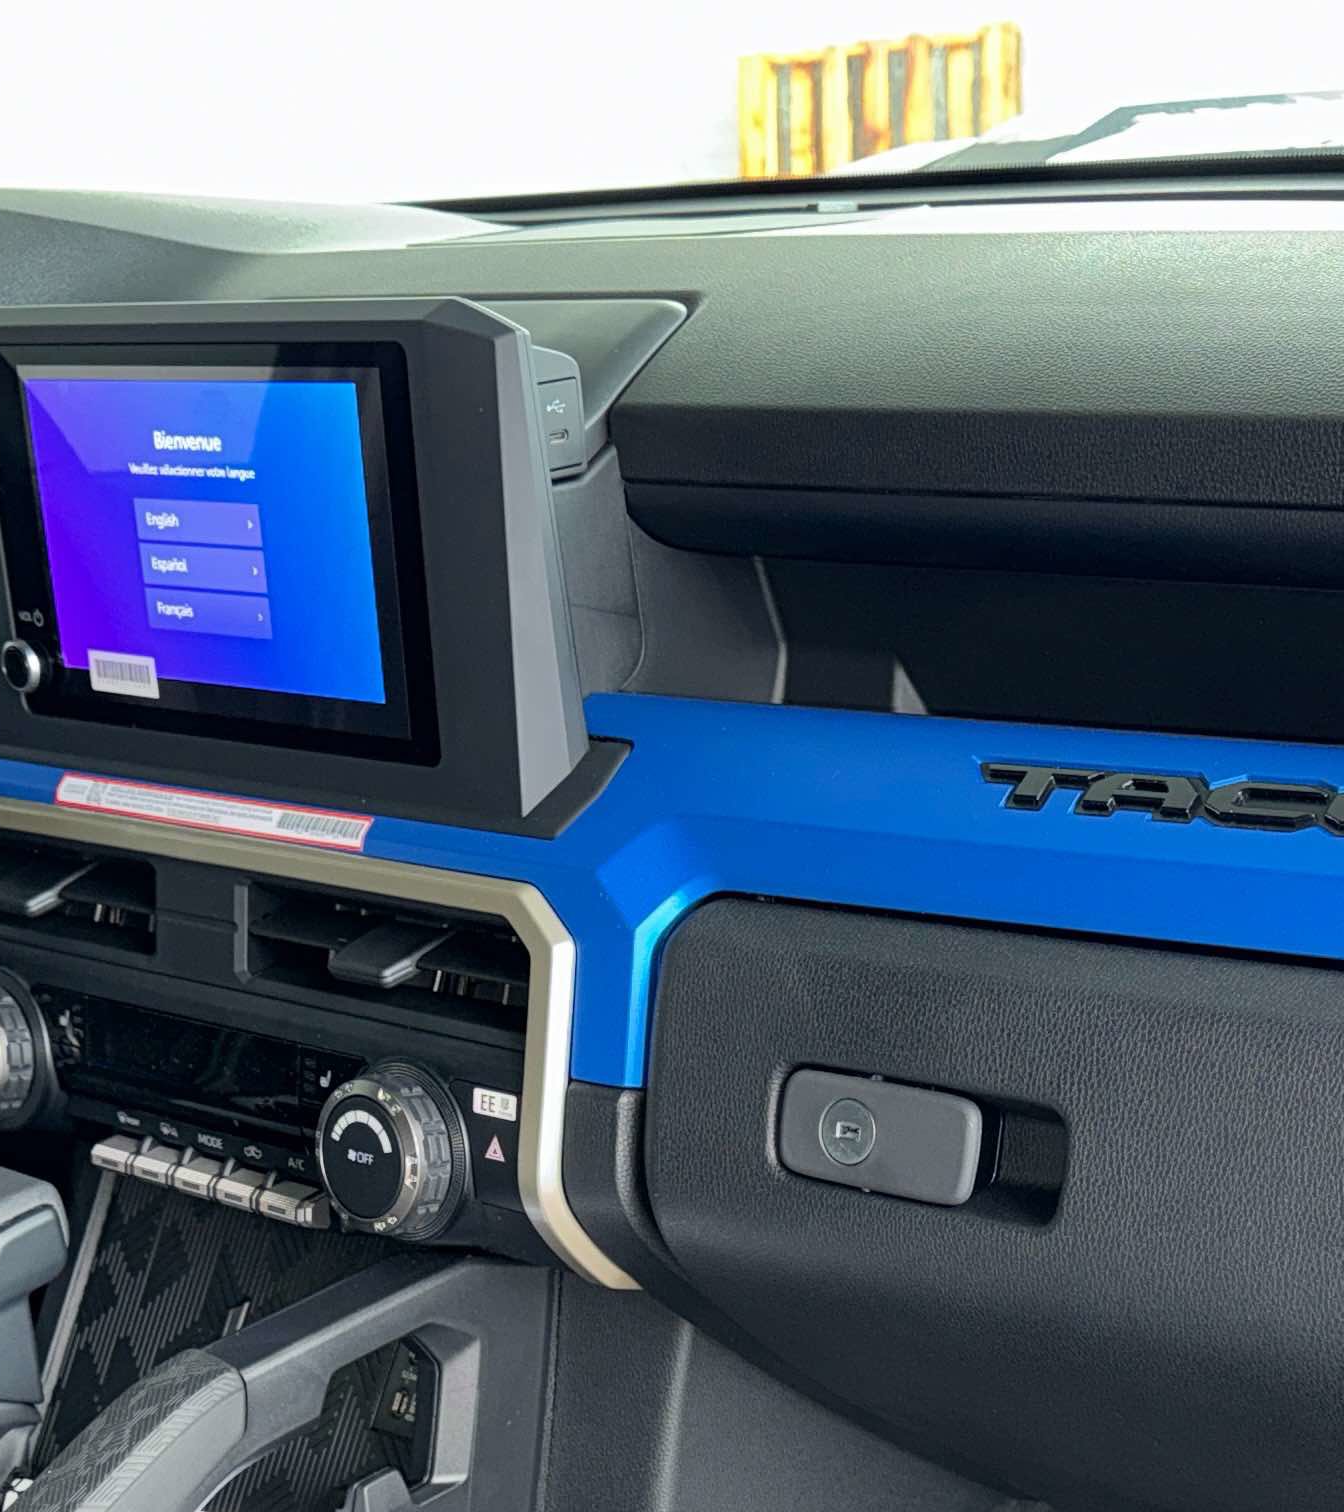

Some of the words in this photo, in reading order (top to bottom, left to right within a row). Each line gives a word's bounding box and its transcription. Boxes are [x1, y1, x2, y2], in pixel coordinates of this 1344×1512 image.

[152, 430, 223, 452] Bienvenue
[145, 512, 180, 530] English
[151, 556, 188, 574] Español
[156, 601, 195, 619] Français
[480, 1094, 496, 1114] EE
[197, 1132, 224, 1150] MODE
[287, 1156, 305, 1171] A/C
[356, 1151, 375, 1166] OFF
